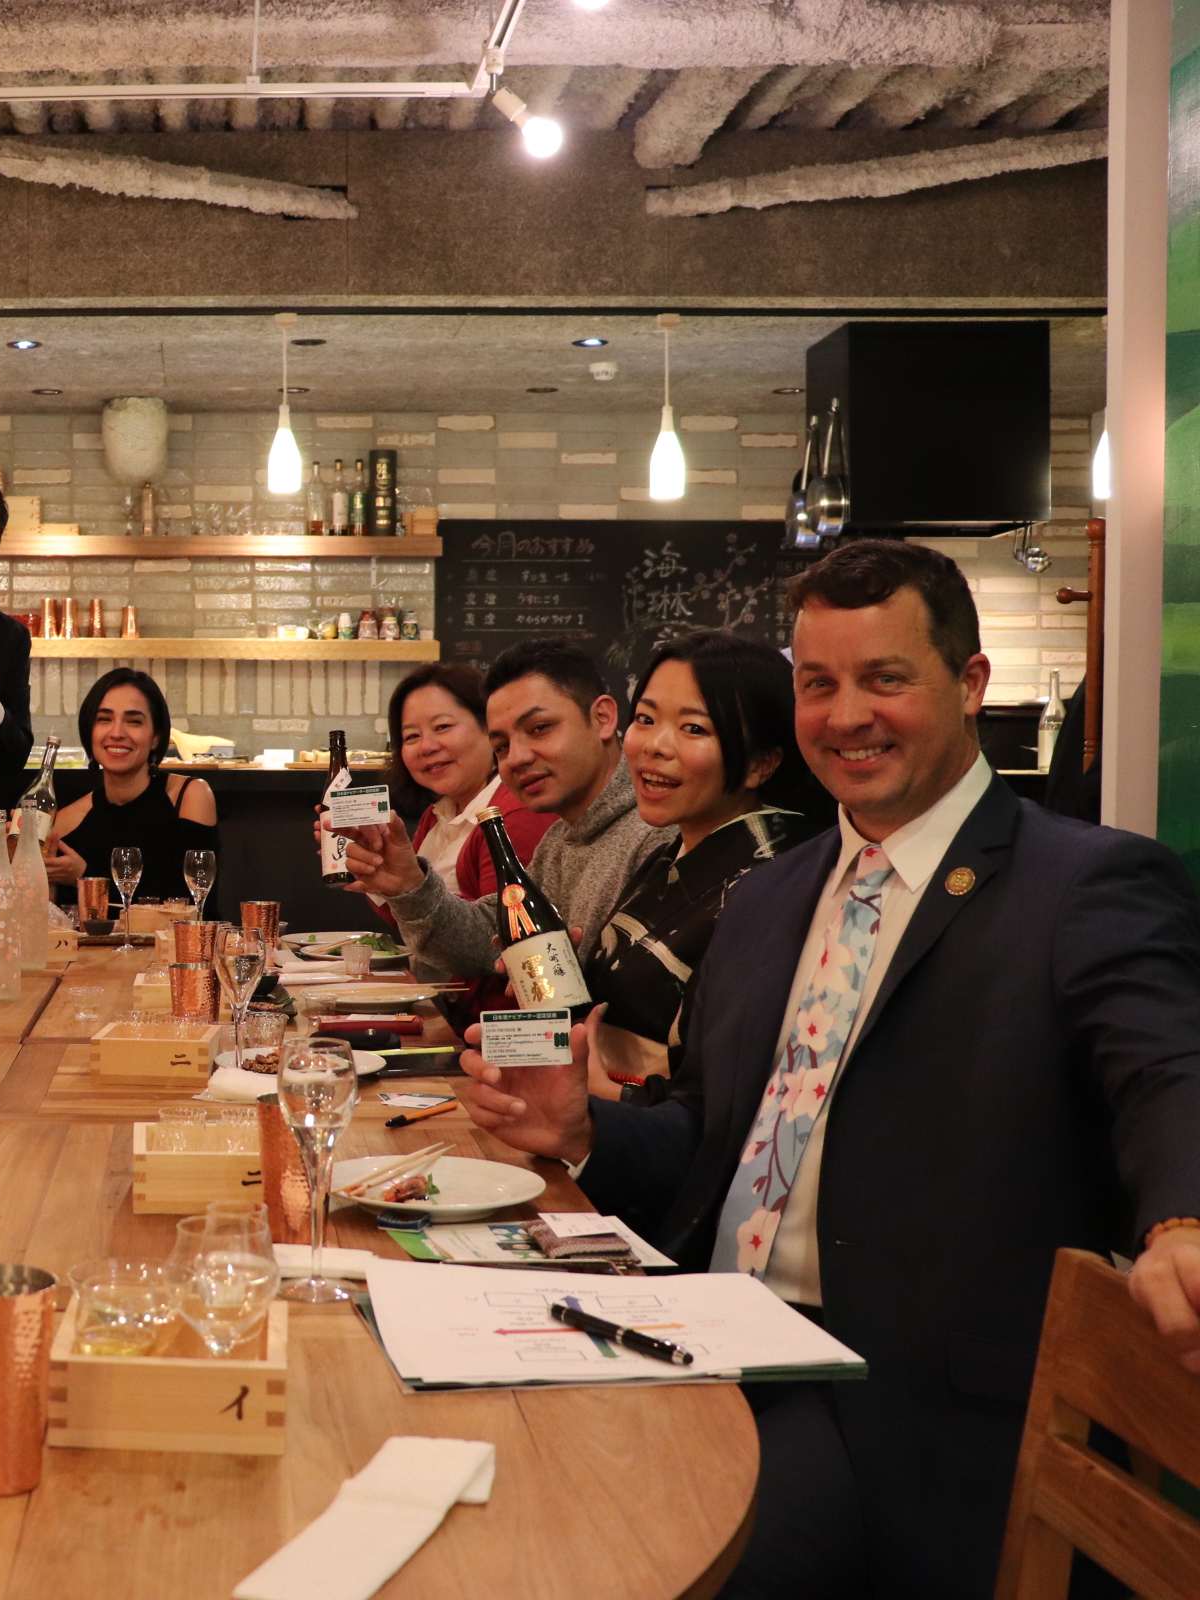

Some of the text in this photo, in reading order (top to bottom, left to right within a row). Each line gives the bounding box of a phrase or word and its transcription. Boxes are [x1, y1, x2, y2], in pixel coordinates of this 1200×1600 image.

[471, 530, 596, 559] 今月のおすすめ
[521, 954, 556, 1003] 富鶴
[492, 1012, 557, 1021] 日本酒ナビゲーター認定証書
[218, 1384, 250, 1422] イ
